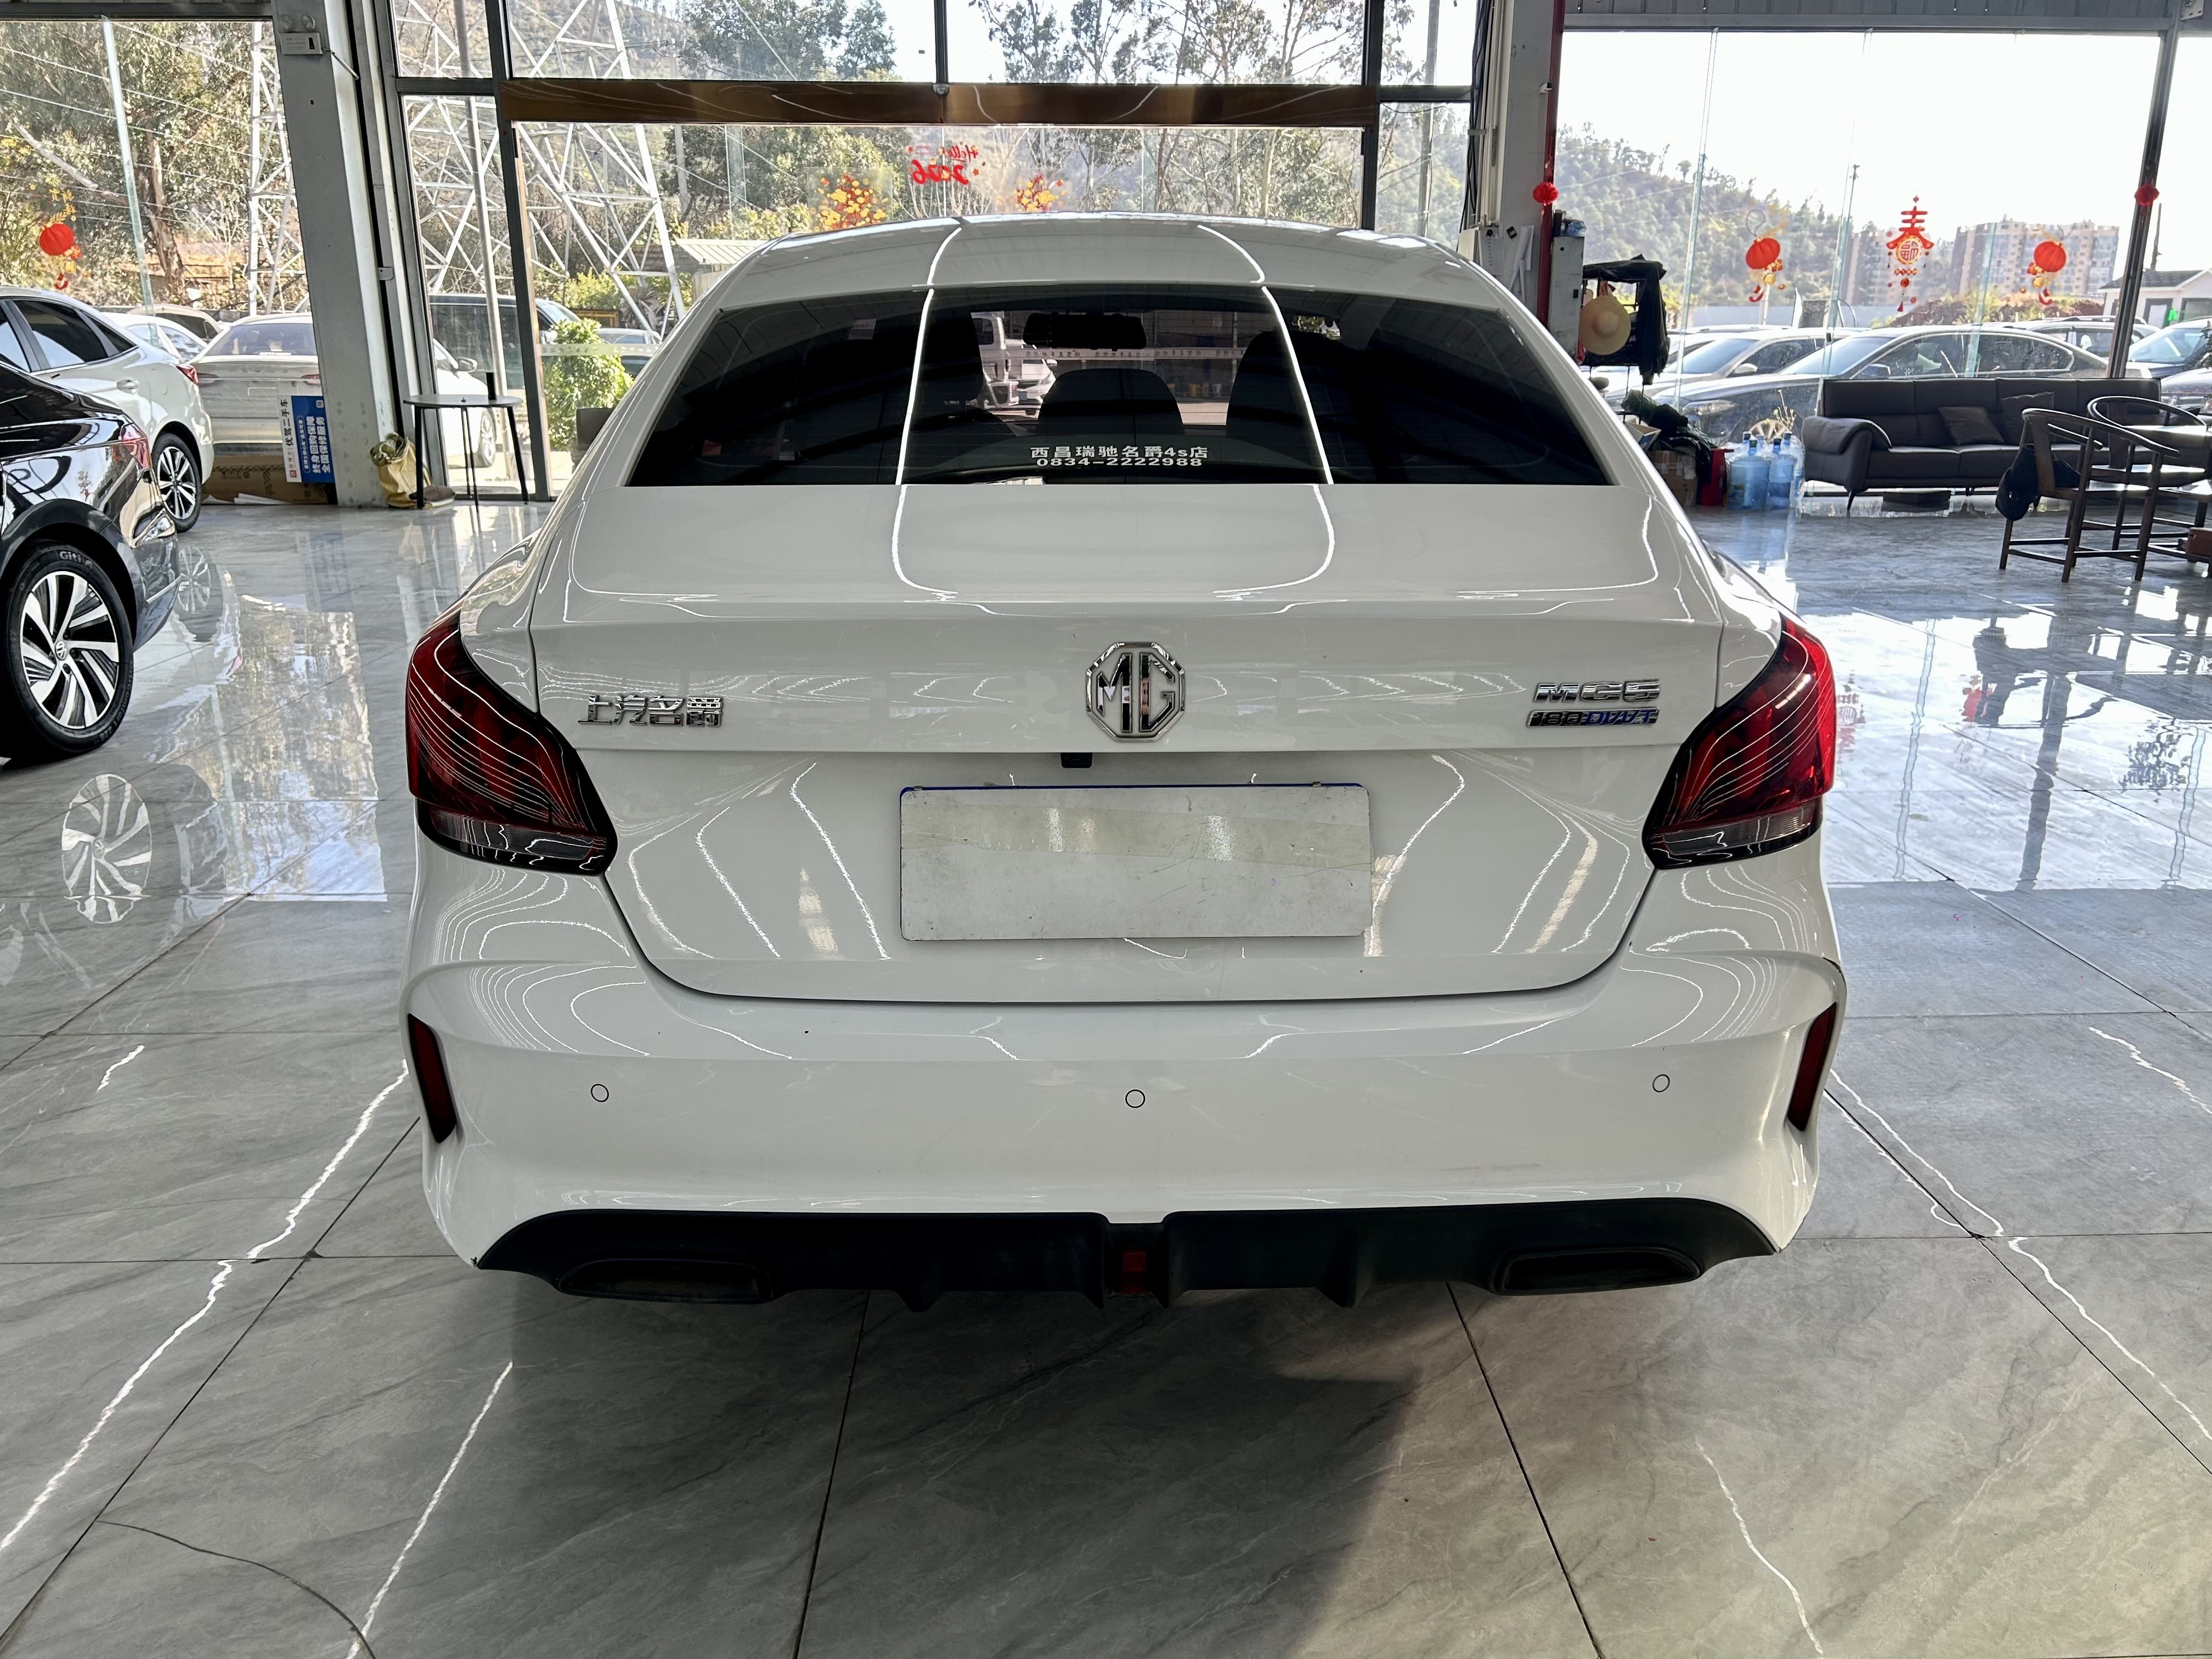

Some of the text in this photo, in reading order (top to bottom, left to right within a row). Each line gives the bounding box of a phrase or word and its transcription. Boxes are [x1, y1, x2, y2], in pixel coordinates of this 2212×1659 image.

[280, 399, 294, 447] 优驾二手车
[306, 416, 321, 473] 终身回购保障
[1030, 445, 1208, 459] 西昌瑞驰名爵4s店
[1036, 458, 1202, 466] 0834-2222988
[59, 551, 82, 563] Giti
[1096, 652, 1175, 733] MG
[1533, 680, 1660, 702] MG5
[577, 695, 723, 727] 上汽名爵
